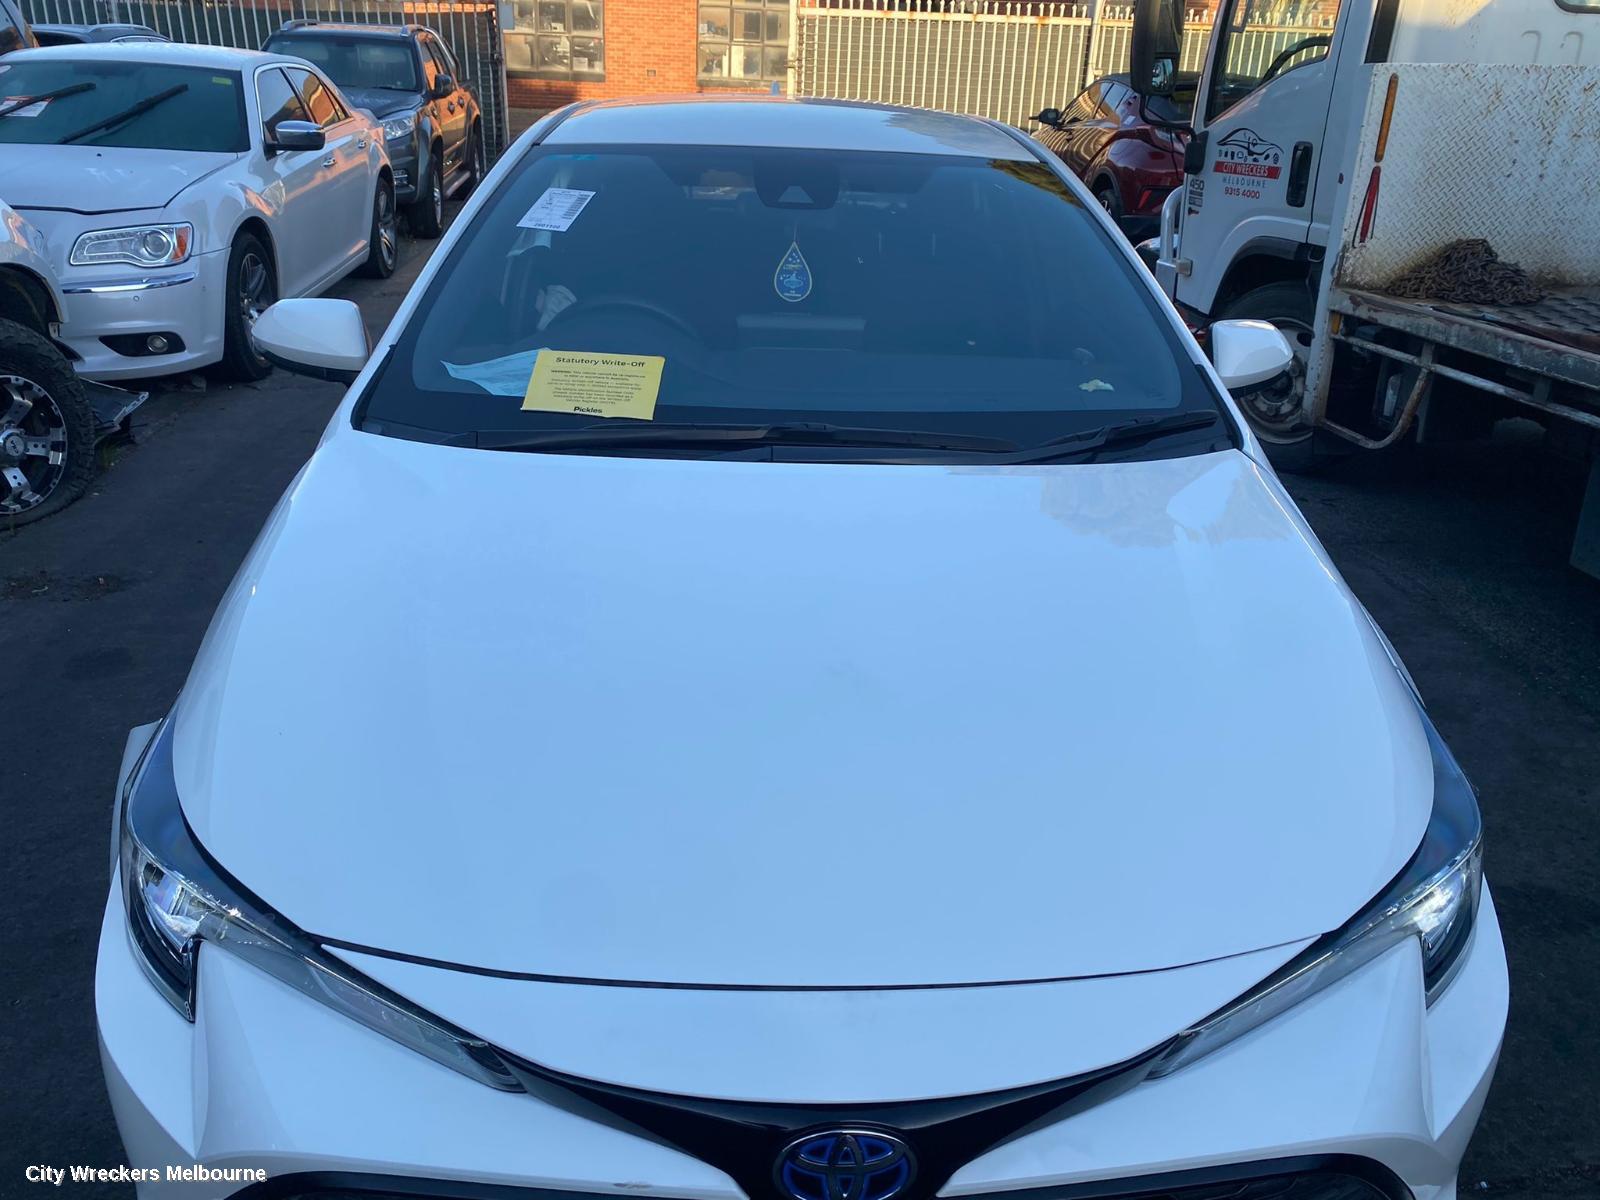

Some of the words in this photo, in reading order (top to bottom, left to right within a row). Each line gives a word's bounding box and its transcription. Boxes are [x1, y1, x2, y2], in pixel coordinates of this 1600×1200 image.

[1223, 162, 1236, 173] CITY
[1236, 164, 1268, 176] WRECKERS
[1222, 176, 1267, 188] MELBOURNE
[1224, 187, 1241, 196] 9315
[1242, 190, 1260, 199] 4000
[556, 357, 600, 365] Statutory
[573, 406, 603, 414] Pickles
